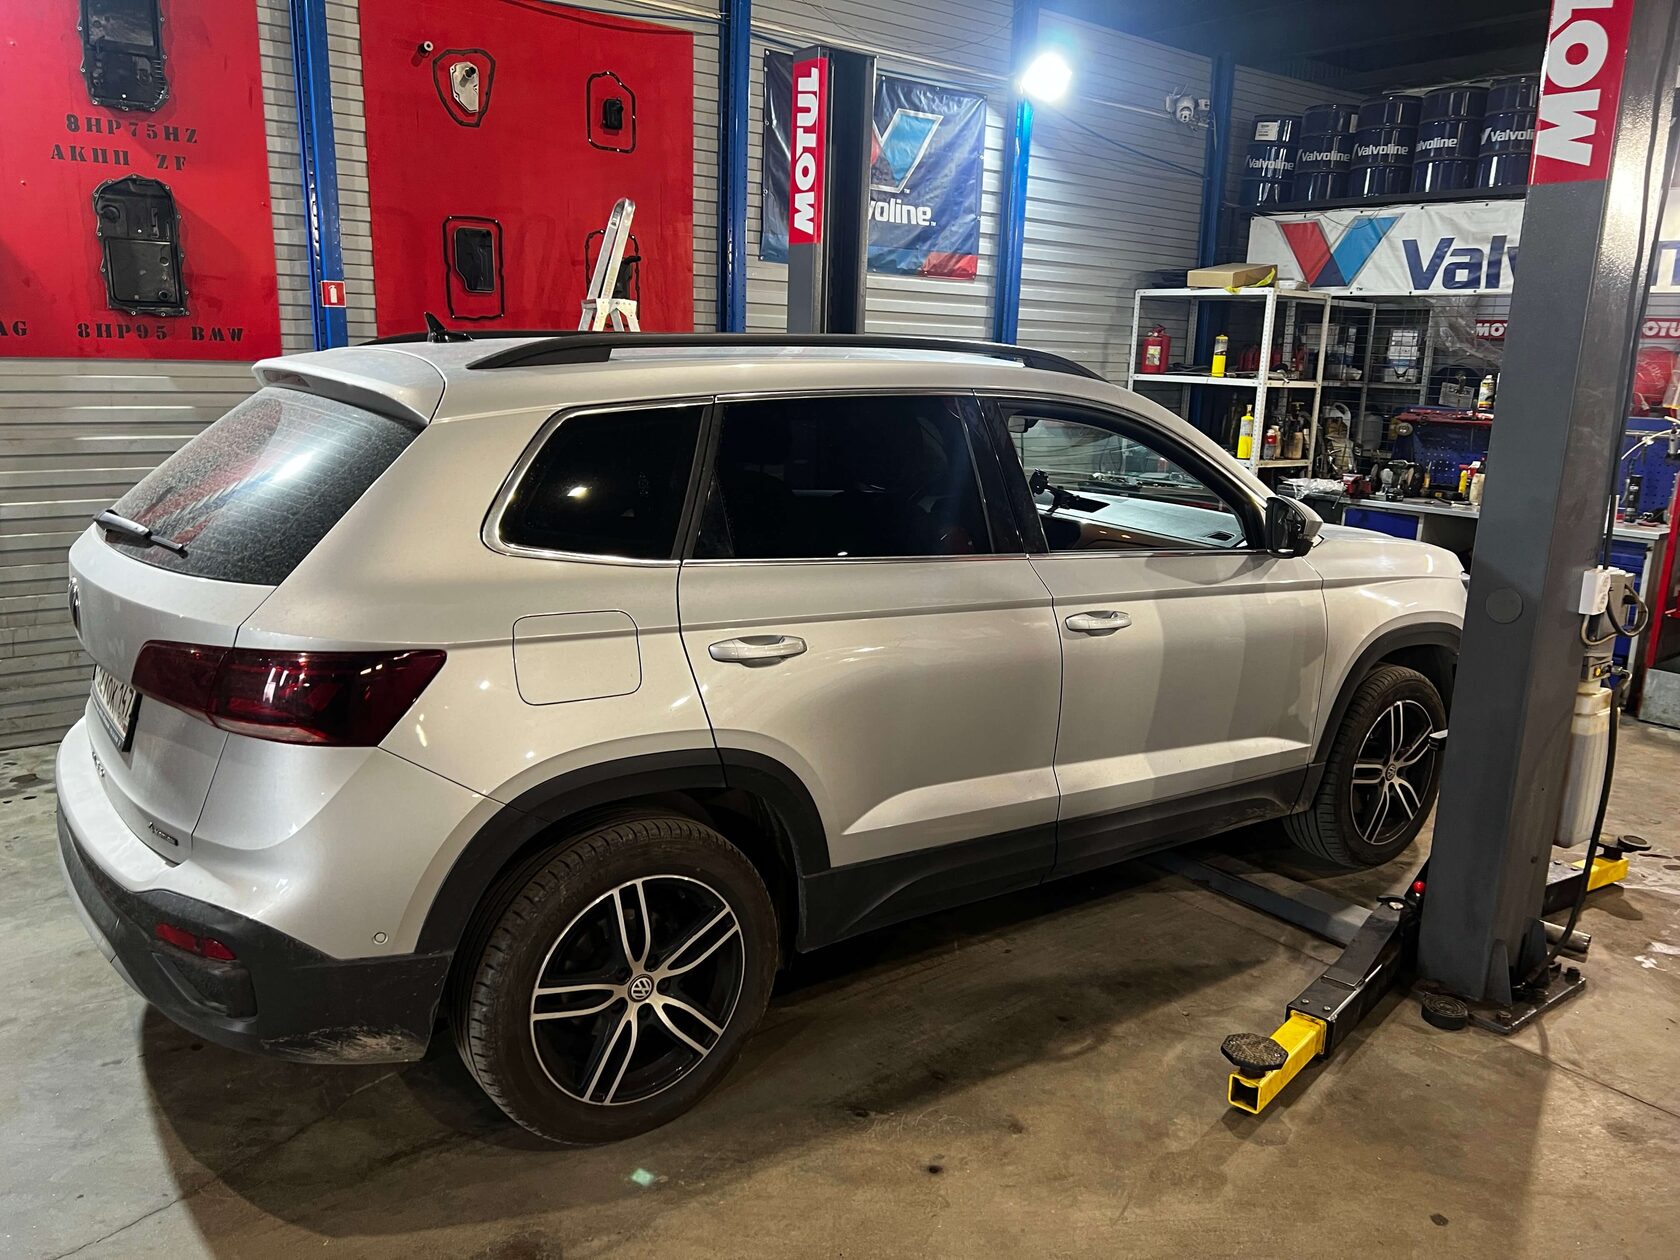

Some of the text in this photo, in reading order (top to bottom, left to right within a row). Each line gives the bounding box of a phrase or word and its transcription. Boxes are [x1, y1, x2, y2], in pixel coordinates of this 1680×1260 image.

[794, 67, 819, 235] MOTUL
[1301, 150, 1351, 162] Valvoline
[1357, 143, 1409, 157] Valvoline
[1248, 157, 1295, 171] Valvoline
[1402, 234, 1519, 290] Val
[77, 322, 168, 340] 8HP95
[191, 326, 243, 342] BMW
[1476, 322, 1508, 337] MO
